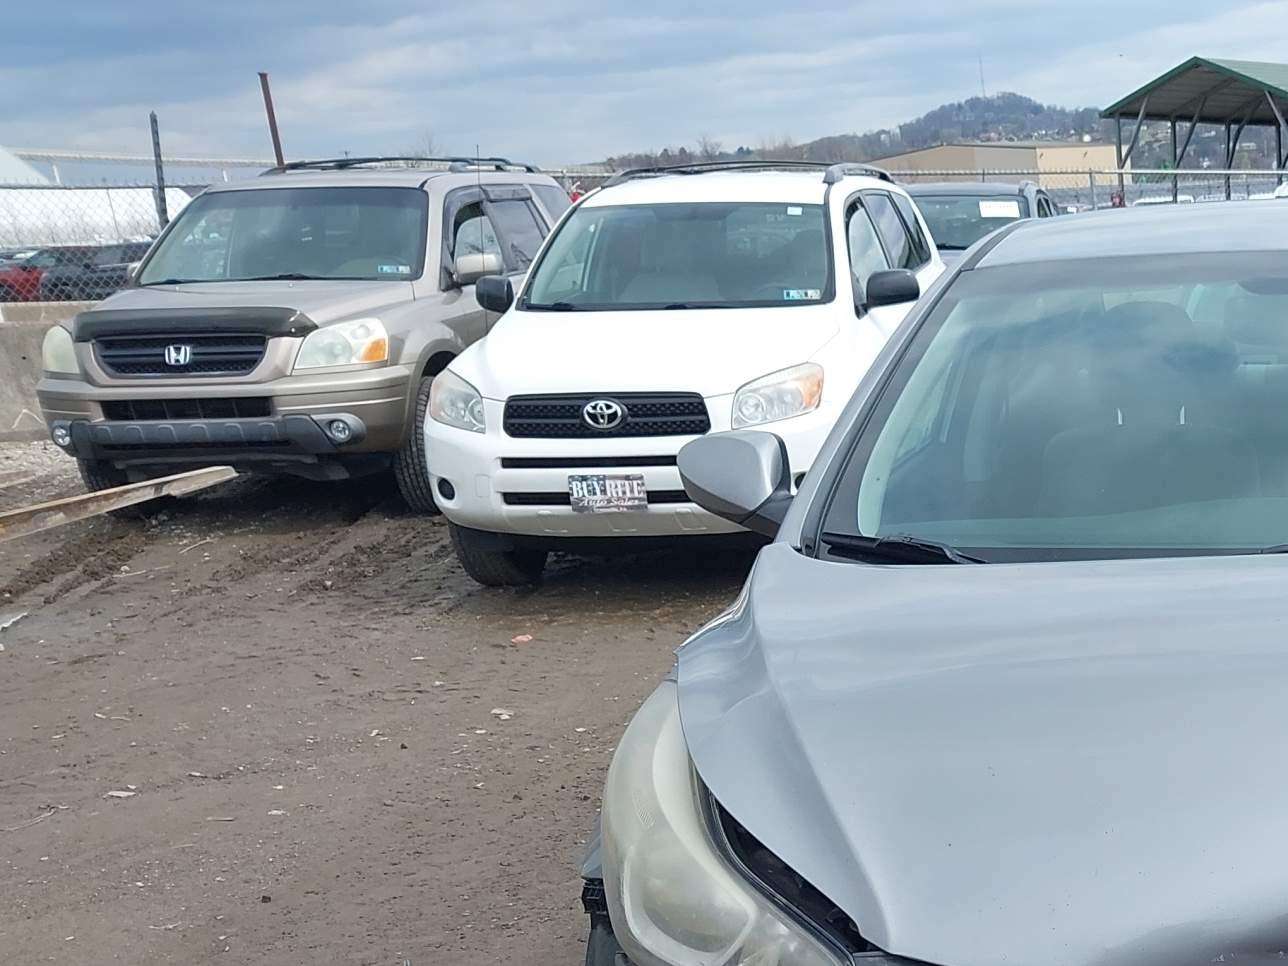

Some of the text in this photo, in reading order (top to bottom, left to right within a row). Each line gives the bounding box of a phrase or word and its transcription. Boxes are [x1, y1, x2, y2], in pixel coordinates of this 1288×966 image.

[572, 479, 644, 497] BUY RITE
[578, 496, 640, 507] Auto Sales
